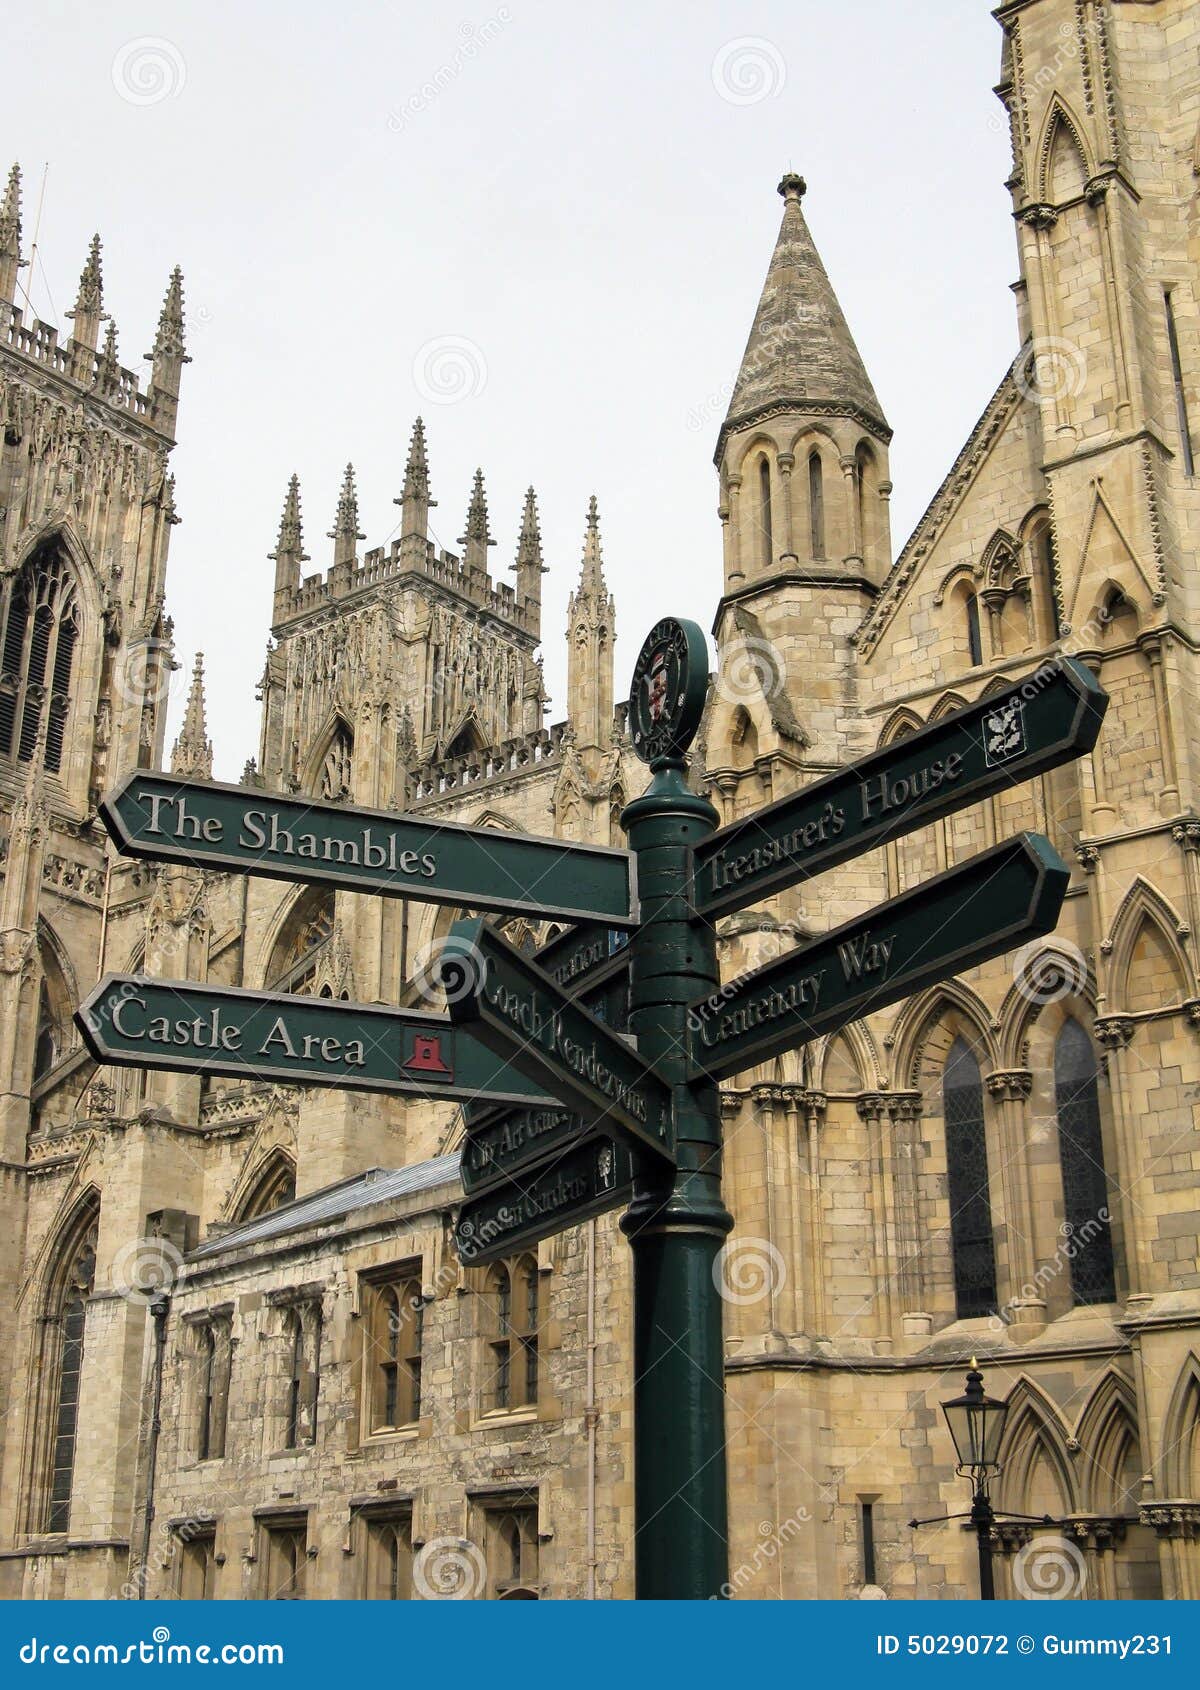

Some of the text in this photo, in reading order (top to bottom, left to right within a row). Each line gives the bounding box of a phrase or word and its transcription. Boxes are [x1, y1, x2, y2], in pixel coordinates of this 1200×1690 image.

[138, 792, 438, 878] The Shambles
[707, 749, 965, 893] Treasurer's House
[111, 996, 366, 1068] Castle Area
[484, 955, 648, 1123] Coach Rendezvous
[700, 932, 898, 1048] Centenary Way
[470, 1138, 497, 1173] City
[499, 1121, 526, 1159] Art
